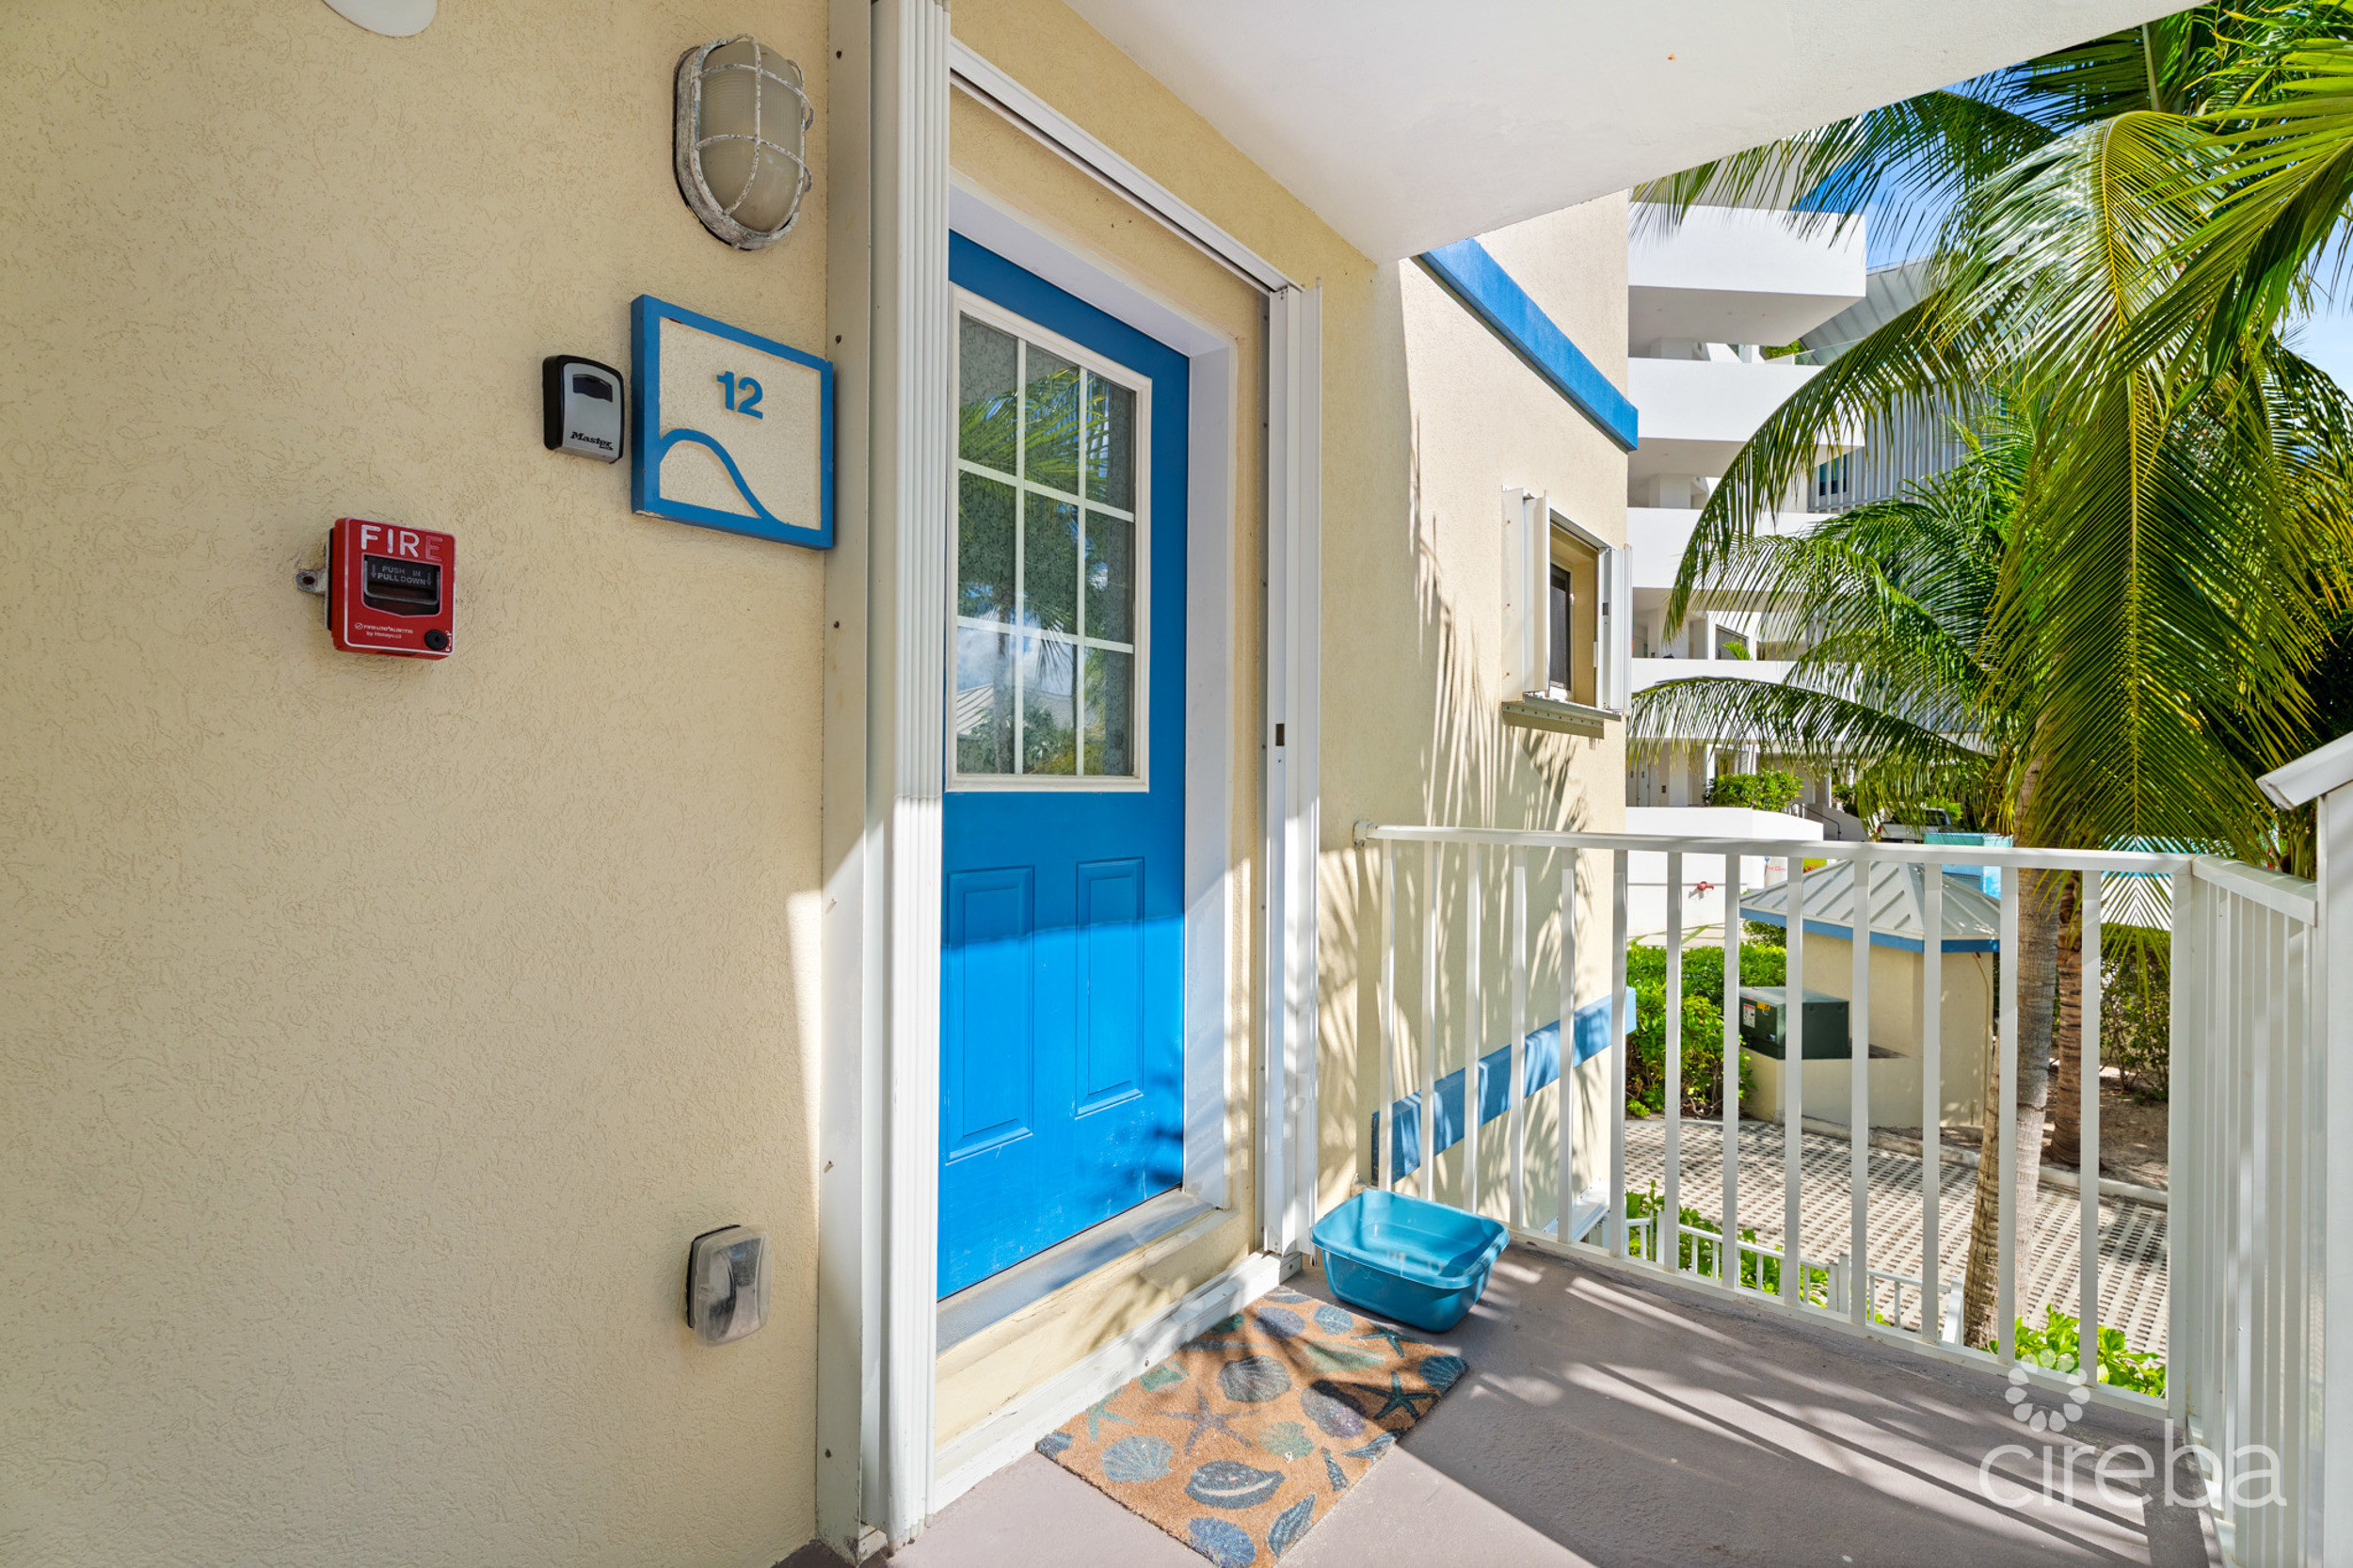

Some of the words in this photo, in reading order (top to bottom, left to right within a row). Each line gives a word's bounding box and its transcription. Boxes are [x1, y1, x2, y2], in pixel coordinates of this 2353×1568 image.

[716, 371, 763, 420] 12
[570, 431, 613, 446] Master
[360, 524, 443, 562] FIRE
[381, 566, 406, 574] PUSH
[377, 572, 400, 582] PULL
[400, 575, 426, 585] DOWN
